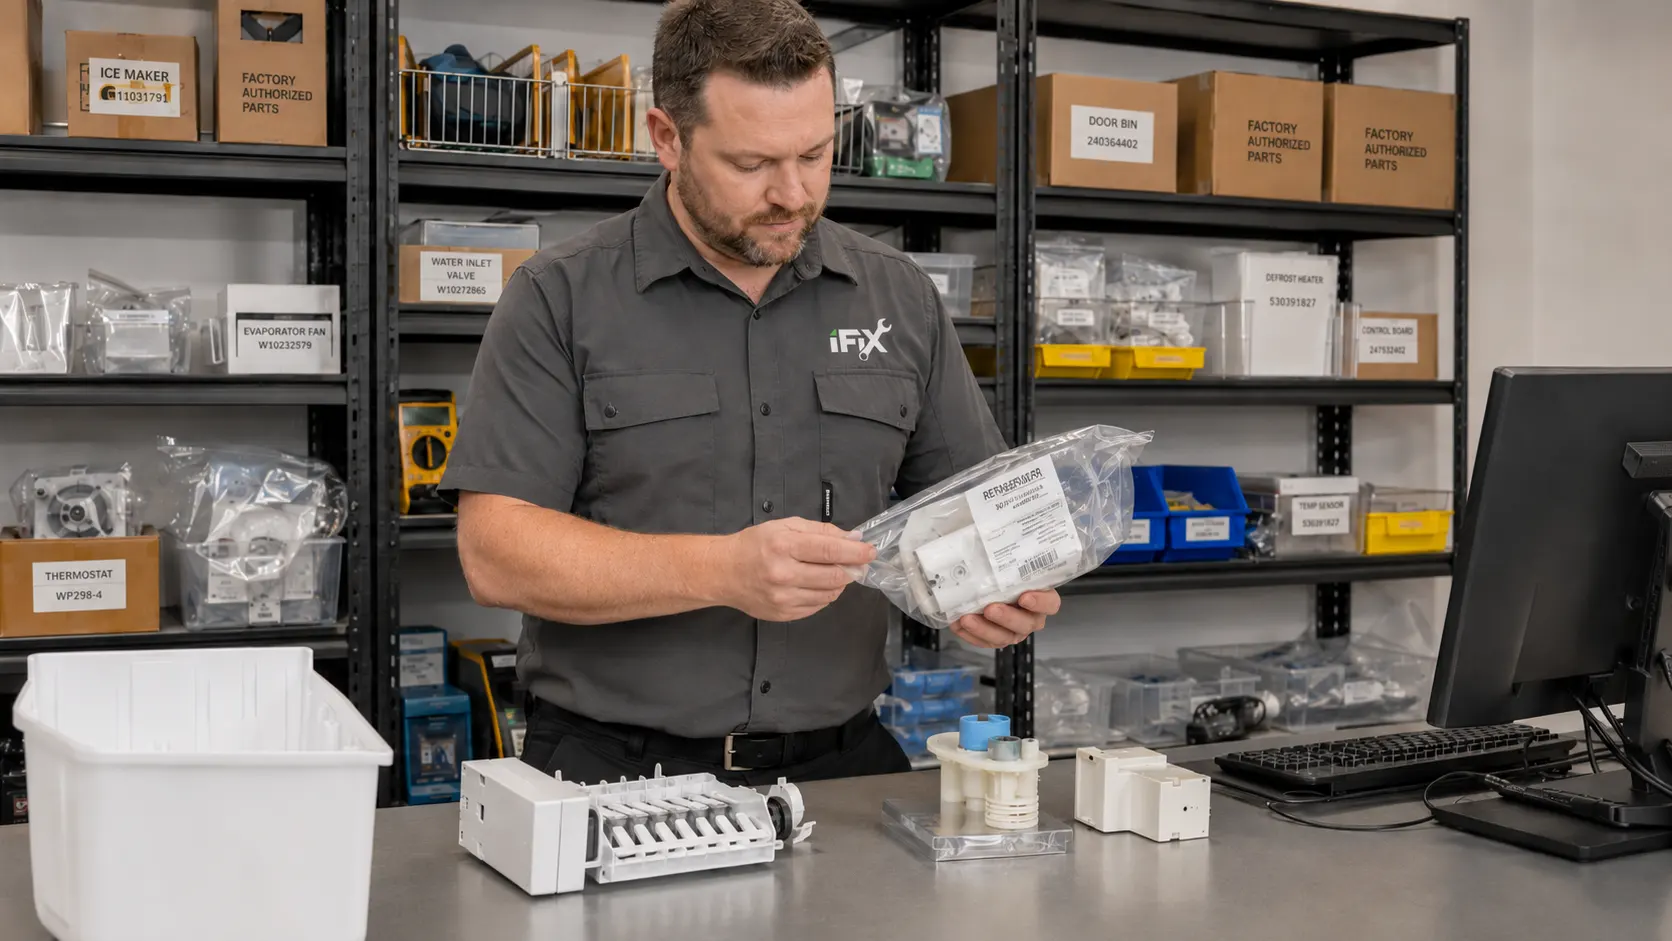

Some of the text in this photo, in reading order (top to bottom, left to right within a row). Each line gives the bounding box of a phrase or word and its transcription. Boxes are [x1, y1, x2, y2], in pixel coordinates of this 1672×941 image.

[100, 67, 169, 82] ICE MAKER
[242, 72, 296, 86] FACTORY
[242, 88, 313, 101] AUTHORIZED
[242, 102, 279, 114] PARTS
[1088, 116, 1138, 130] DOOR BIN
[1247, 120, 1298, 135] FACTORY
[1365, 127, 1414, 142] FACTORY
[1087, 136, 1138, 149] 240364402
[1247, 135, 1311, 151] AUTHORIZED
[1364, 143, 1427, 158] AUTHORIZED
[1247, 151, 1282, 164] PARTS
[1364, 158, 1398, 171] PARTS
[431, 257, 492, 268] WATER INLET
[446, 271, 476, 280] VALVE
[1265, 273, 1324, 284] DEFROST HEATER
[243, 327, 326, 336] EVAPORATOR FAN
[1361, 326, 1391, 335] CONTROL
[258, 340, 312, 350] W10232579
[44, 569, 113, 581] THERMOSTAT
[55, 590, 102, 601] WP298-4
